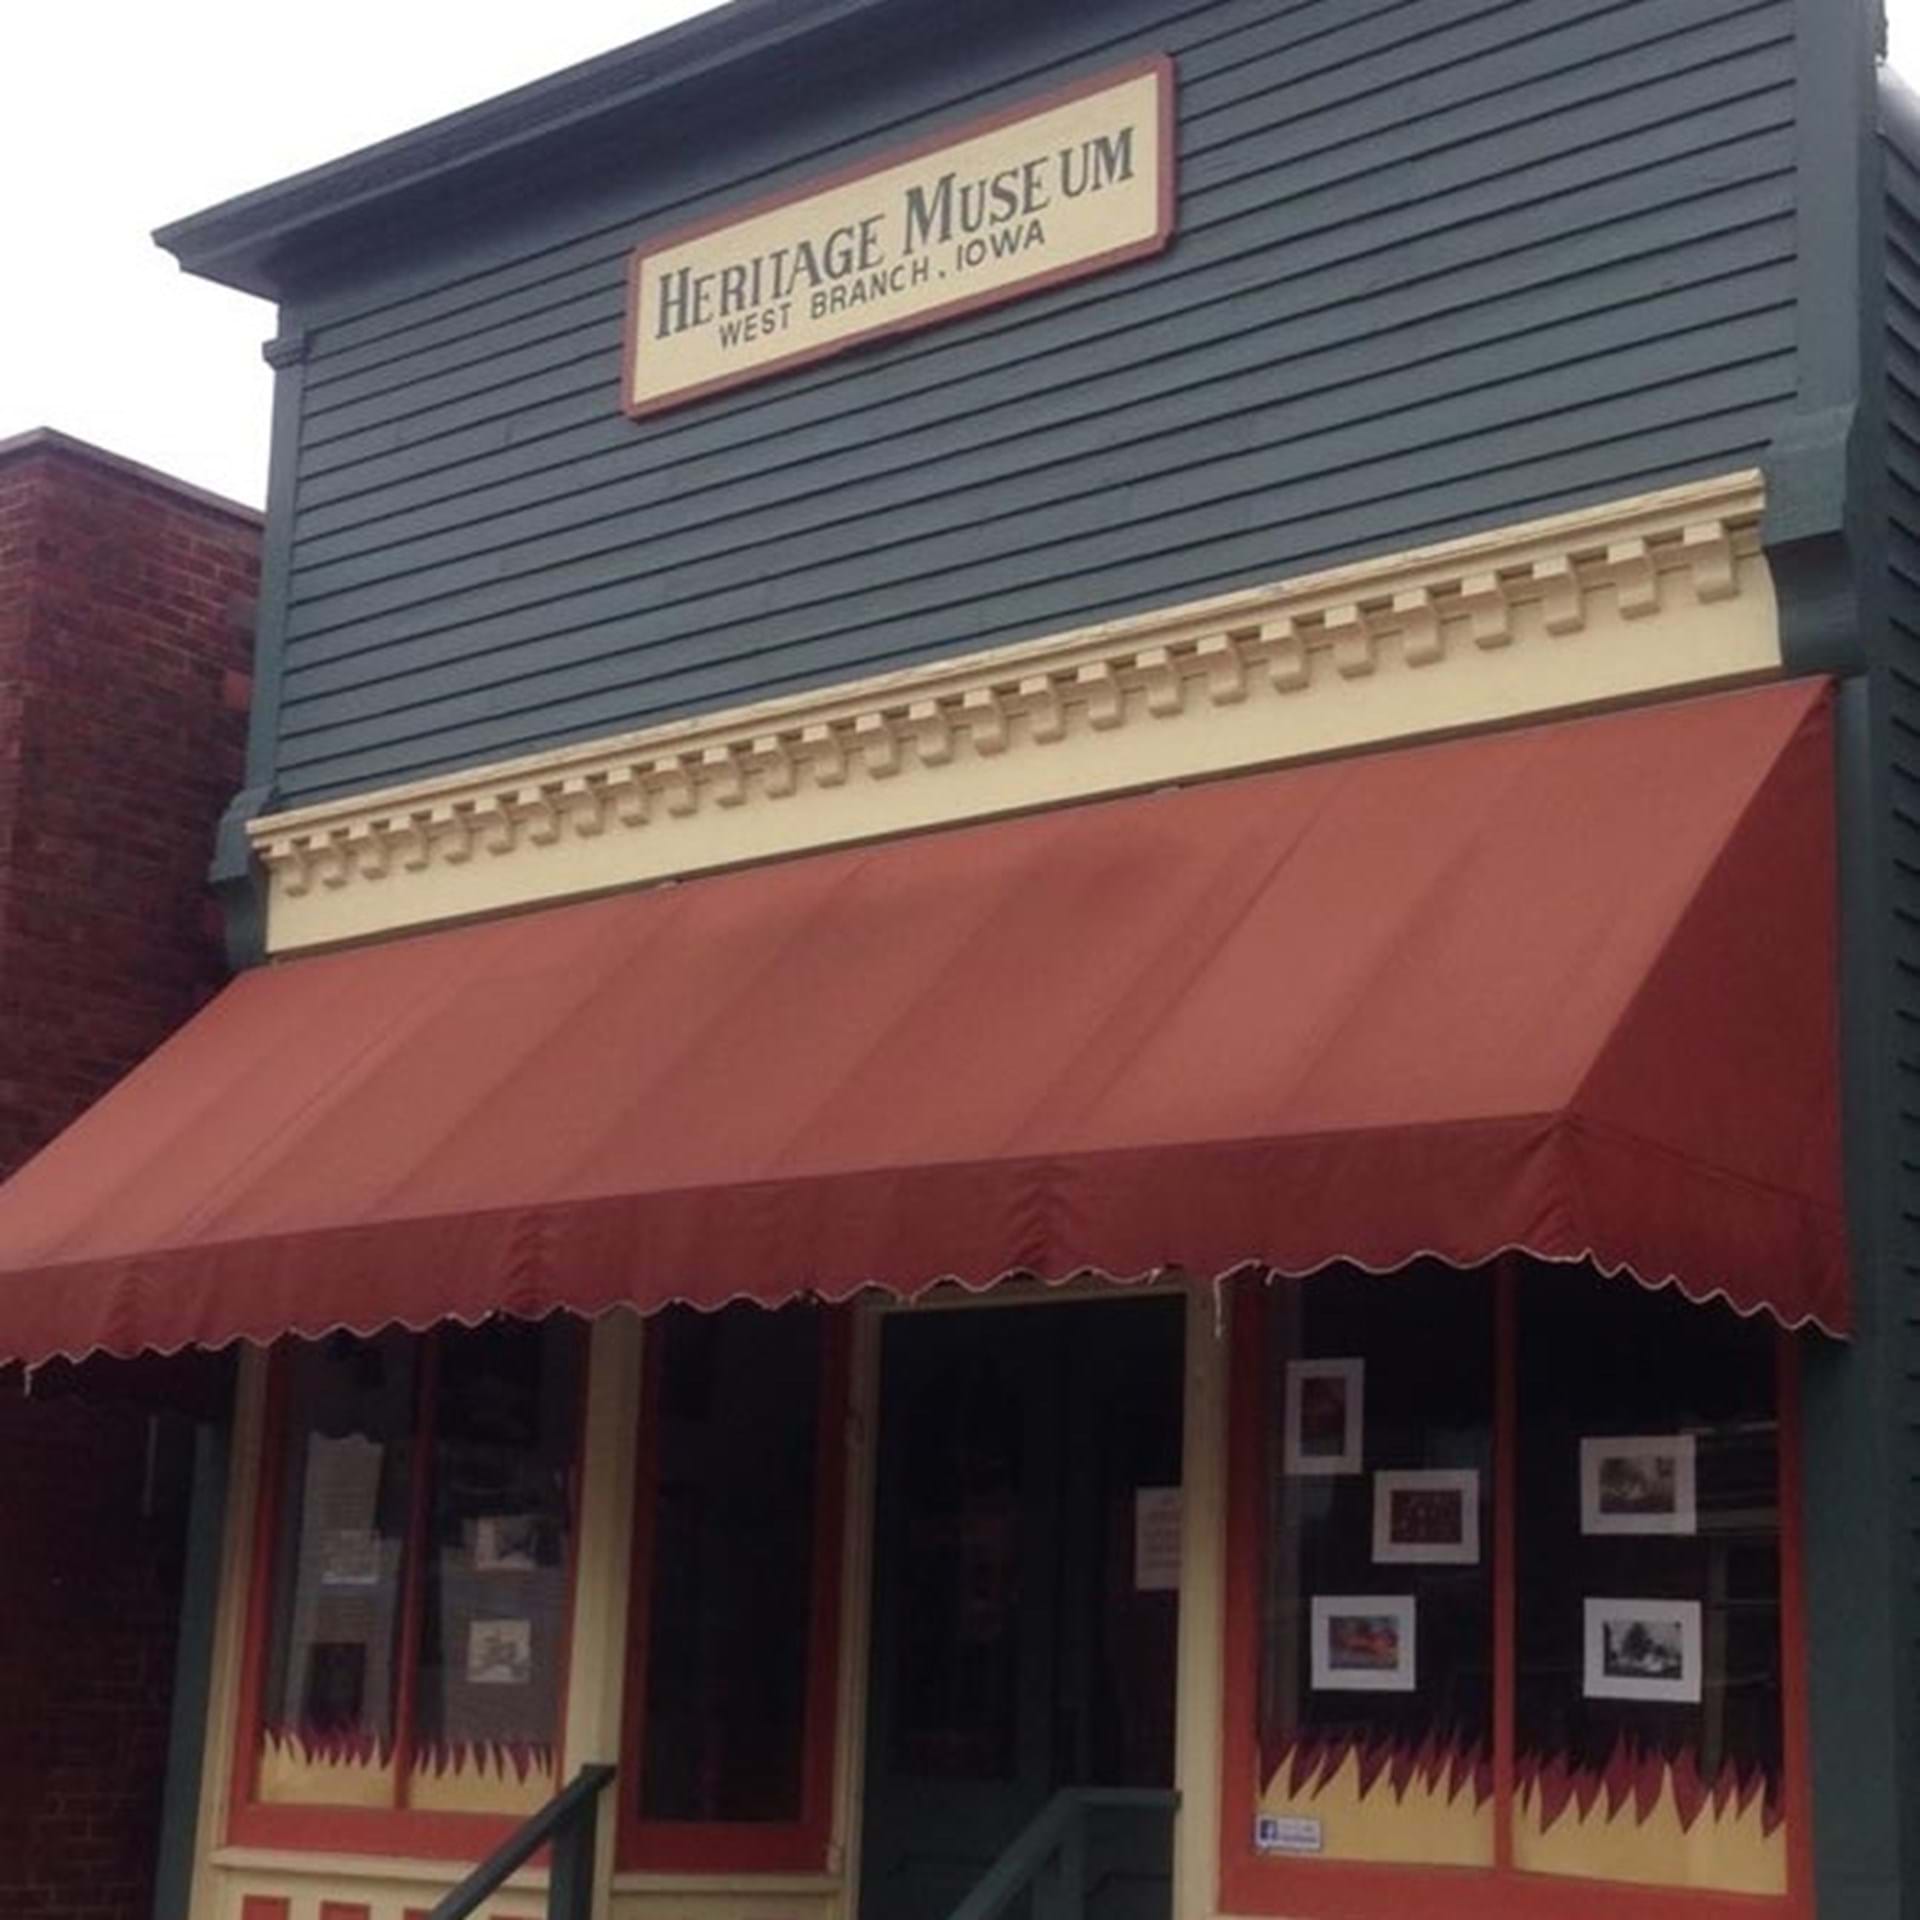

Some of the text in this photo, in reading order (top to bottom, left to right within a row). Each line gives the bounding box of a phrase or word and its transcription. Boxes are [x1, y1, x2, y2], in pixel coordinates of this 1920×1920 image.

[655, 213, 886, 340] HERITAGE
[718, 302, 792, 349] WEST
[956, 218, 1046, 271] IOWA
